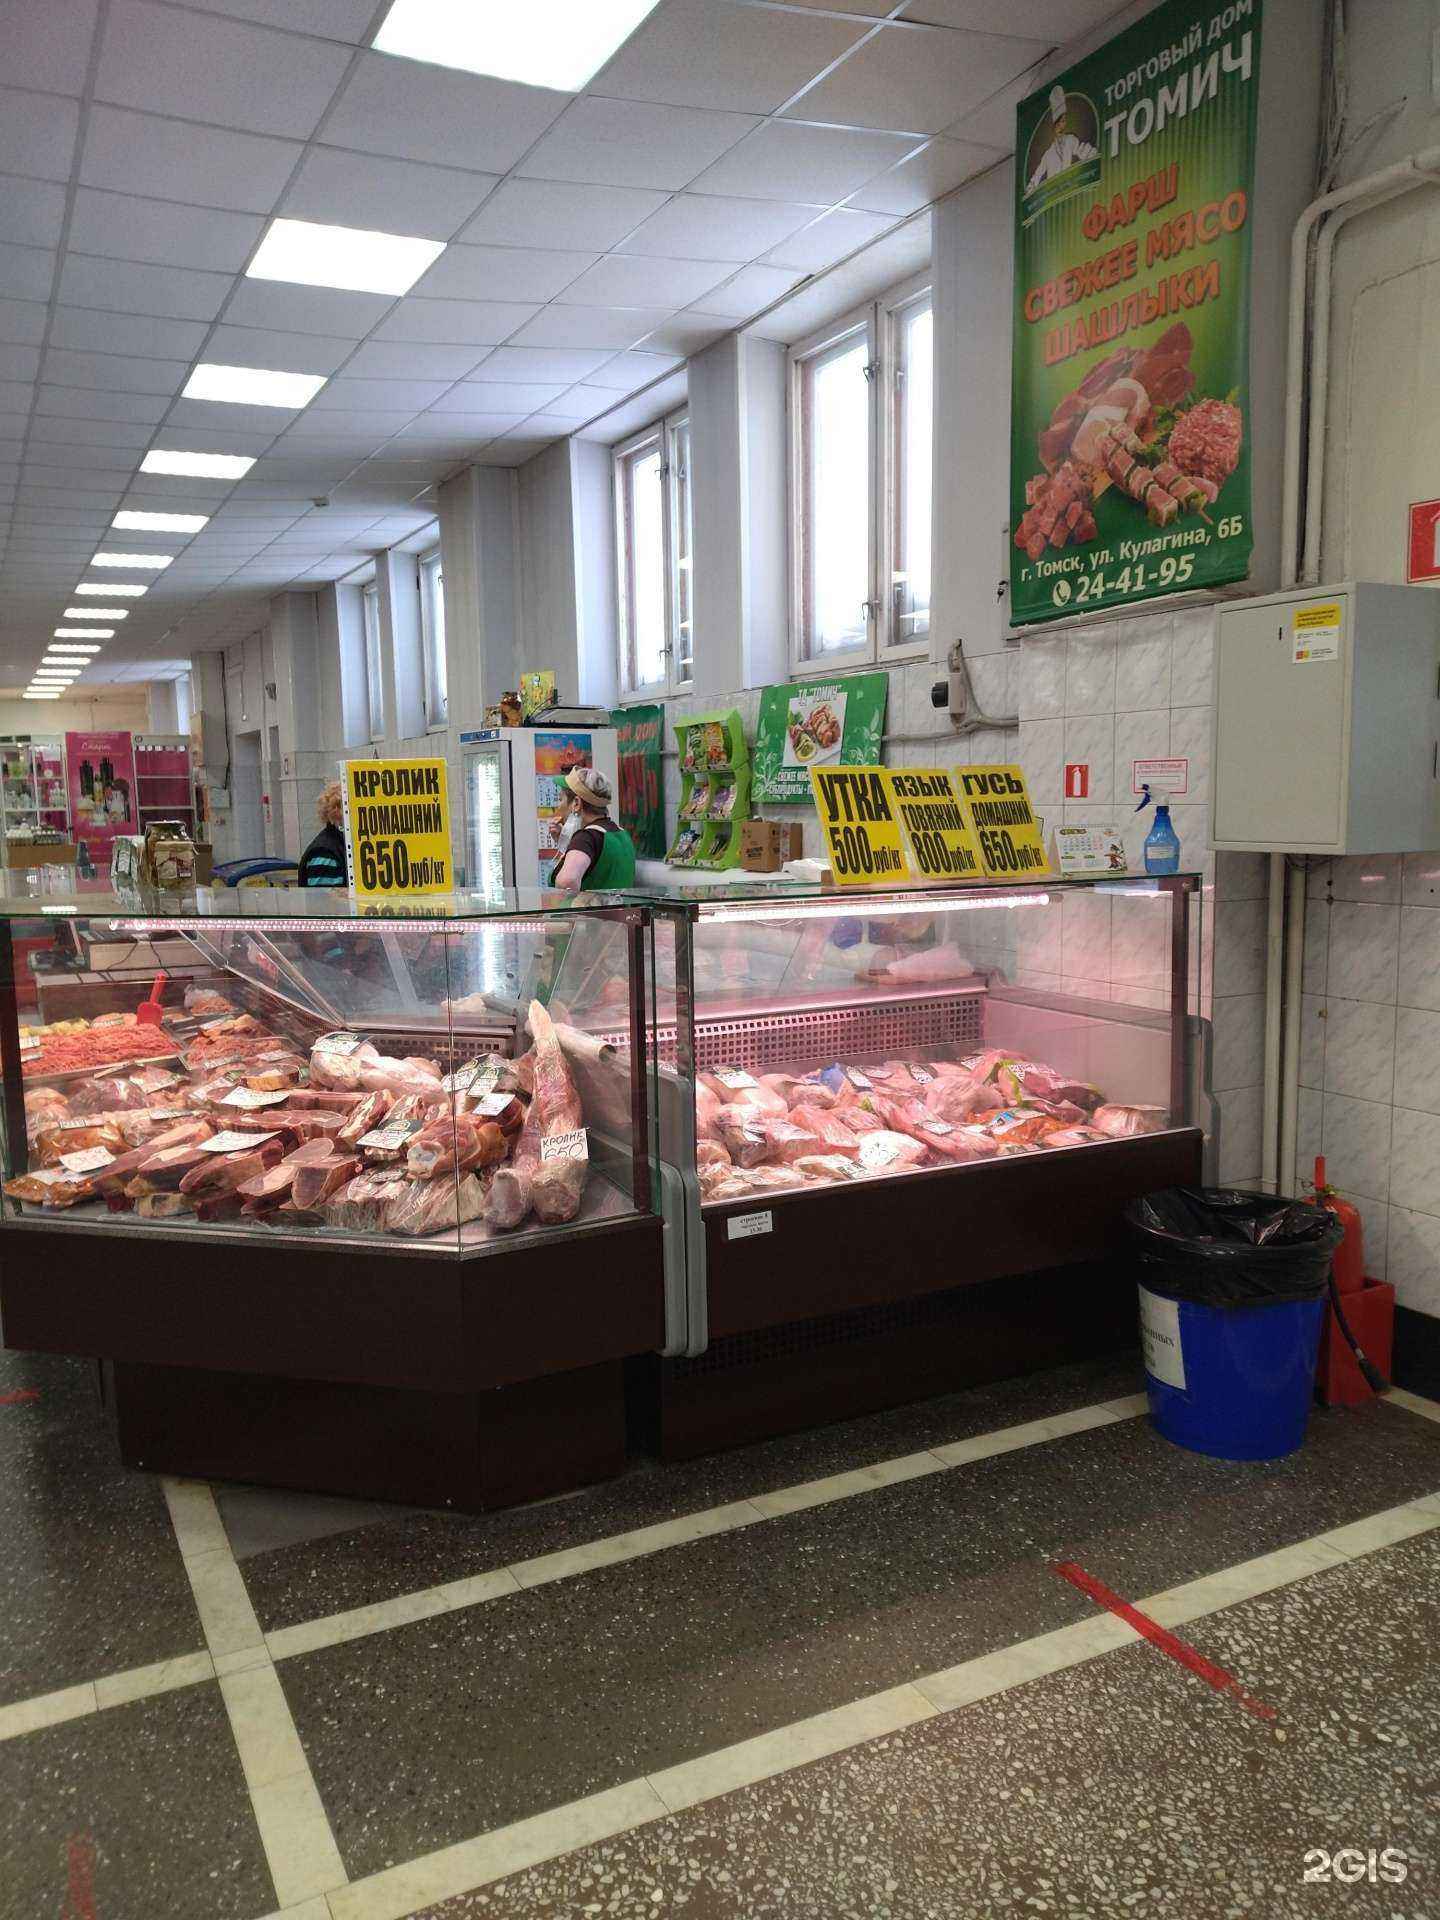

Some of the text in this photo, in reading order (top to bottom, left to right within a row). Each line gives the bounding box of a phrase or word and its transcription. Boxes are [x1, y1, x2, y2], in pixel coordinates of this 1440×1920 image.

[1104, 0, 1253, 106] ТОРГОВЫЙ ДОМ
[1104, 30, 1253, 160] ТОМИЧ
[1082, 162, 1179, 241] ФАРШ
[1023, 190, 1248, 324] СВЕЖЕЕ МЯСО
[1043, 259, 1221, 367] ШАШЛЫКИ
[1021, 567, 1033, 582] г.
[1035, 557, 1085, 578] Томск,
[1089, 552, 1114, 571] ул.
[1119, 528, 1212, 562] Кулагина,
[1075, 553, 1196, 604] 24-41-95
[353, 768, 440, 797] КРОЛИК
[817, 773, 893, 822] УТКА
[891, 775, 953, 797] ЯЗЫК
[962, 773, 1024, 796] ГУСЬ
[358, 798, 442, 842] ДОМАШНИЙ
[971, 796, 1033, 830] ДОМАШНИЙ
[359, 838, 410, 890] 650
[829, 825, 873, 875] 500
[911, 831, 951, 874] 800
[979, 829, 1018, 872] 650
